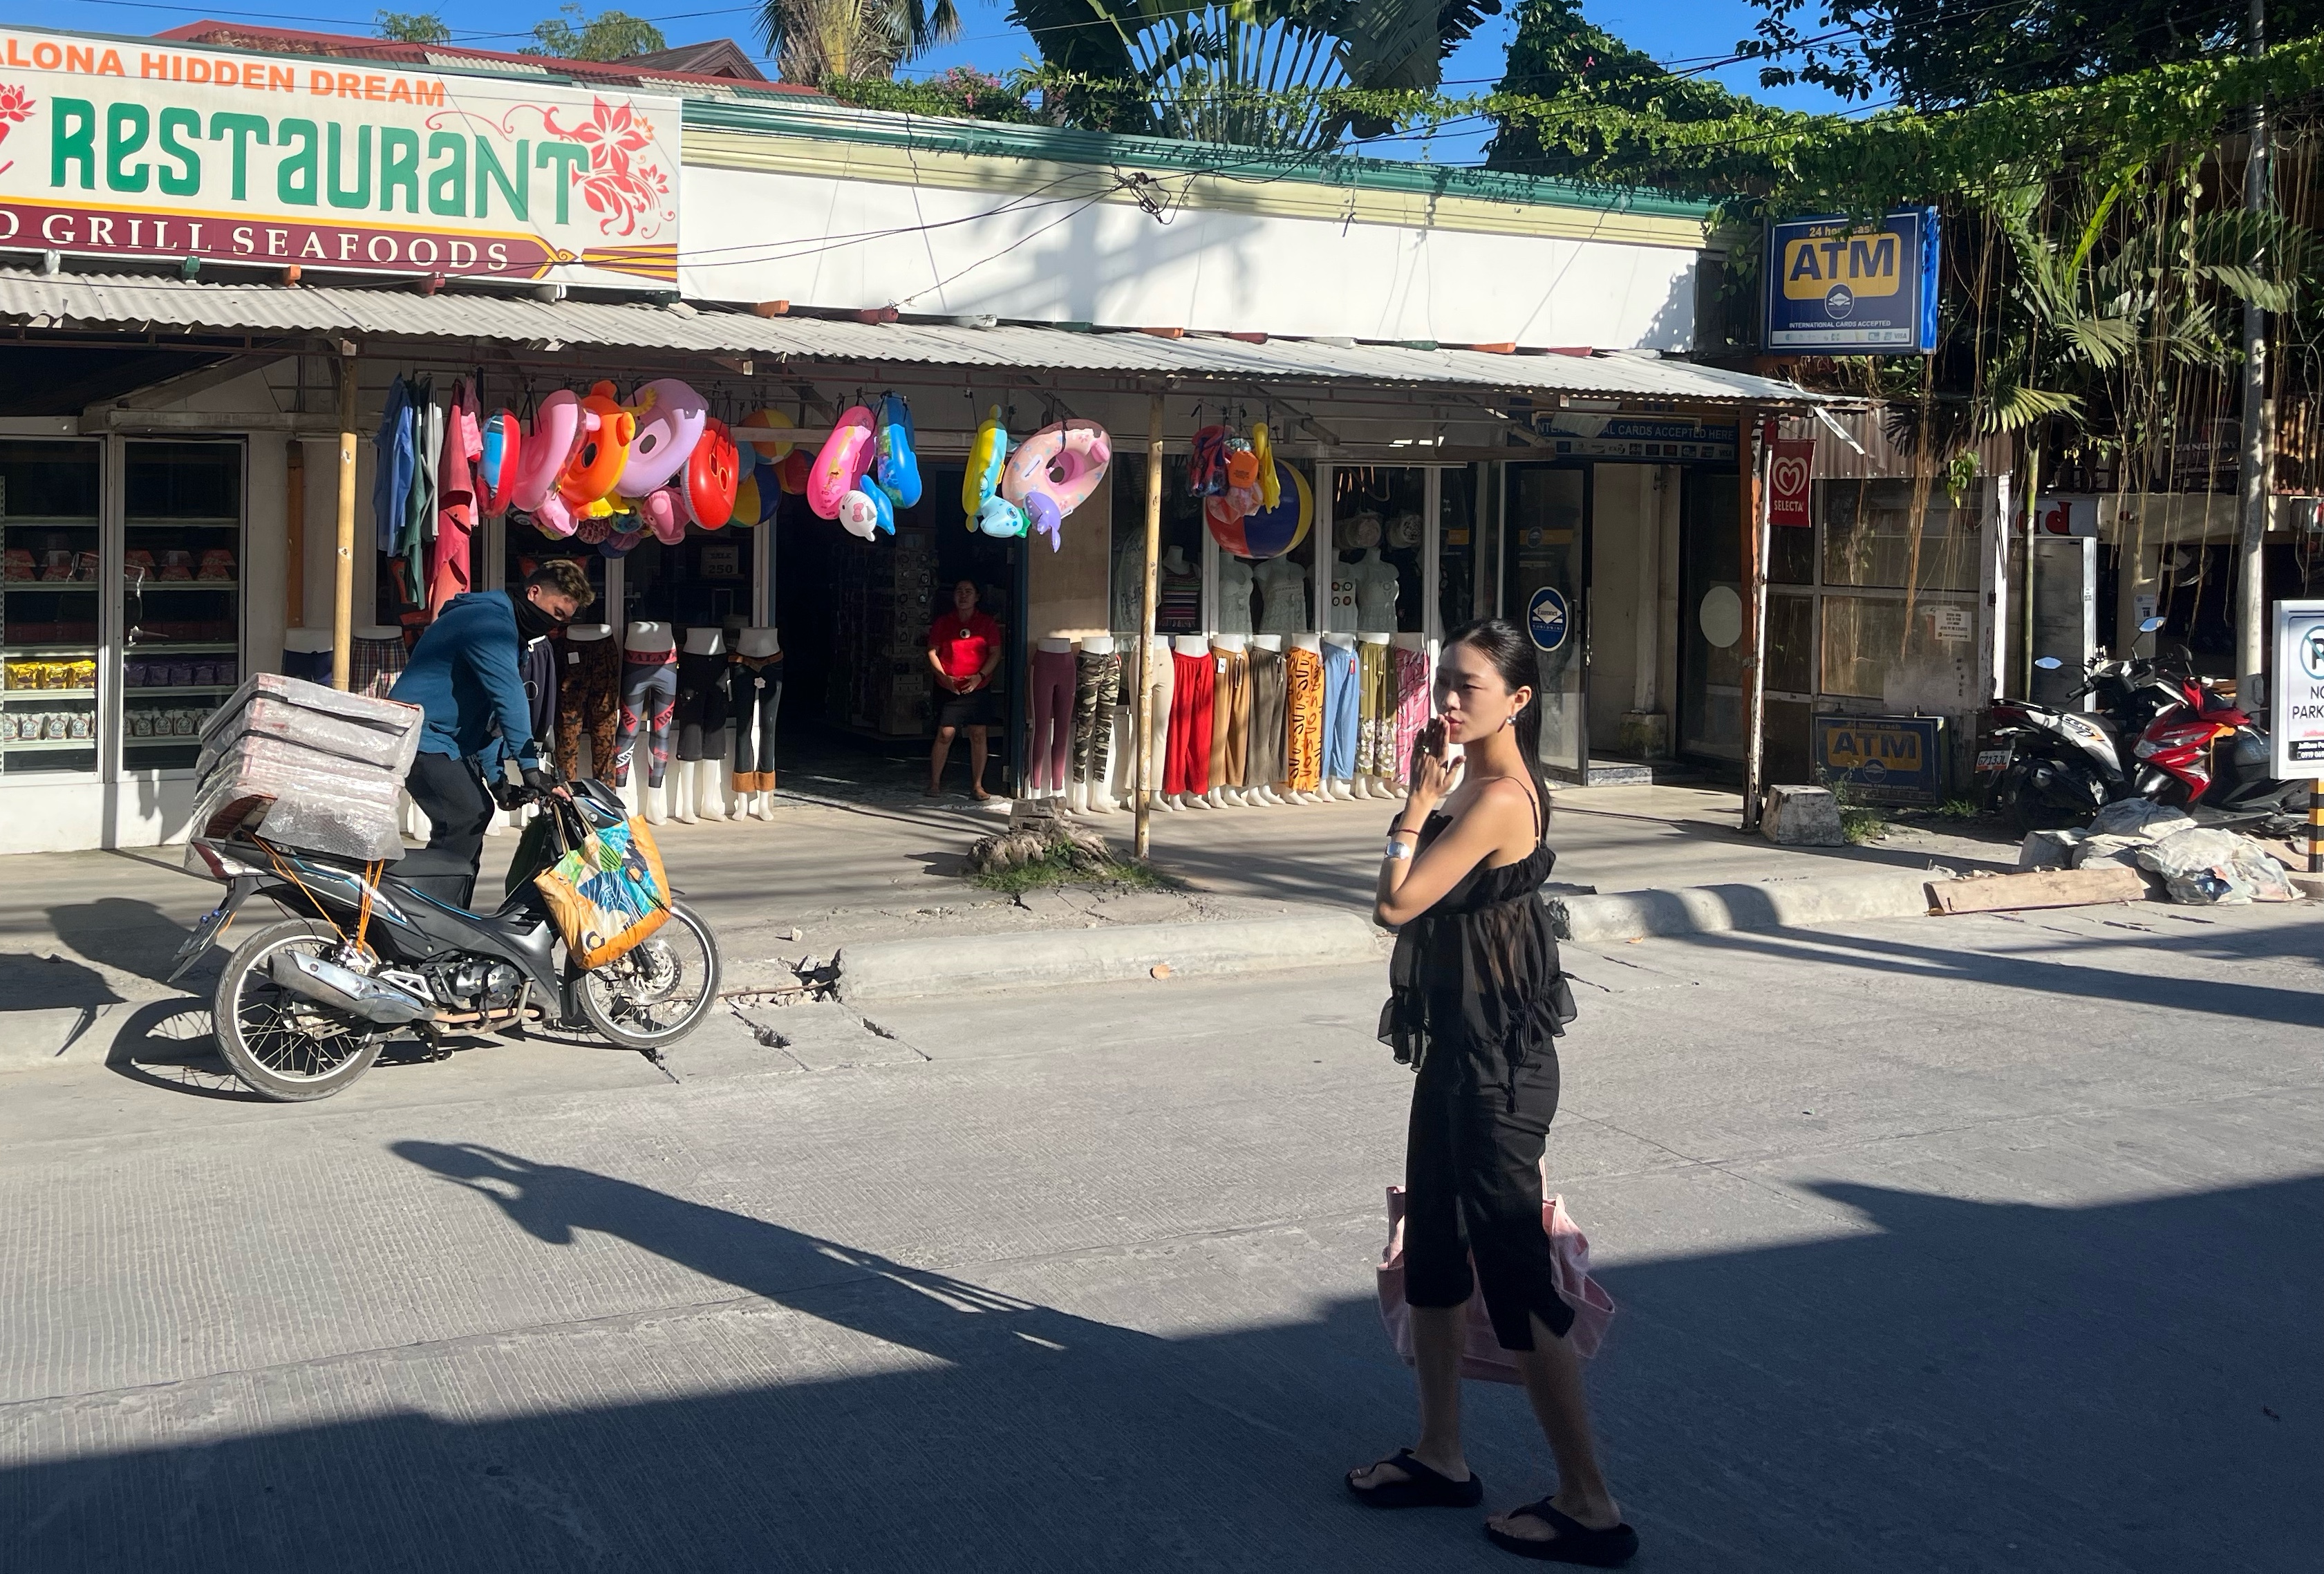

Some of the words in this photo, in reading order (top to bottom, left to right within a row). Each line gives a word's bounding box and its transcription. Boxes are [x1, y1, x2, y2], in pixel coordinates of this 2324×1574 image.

[140, 52, 294, 93] HIDDEN
[310, 69, 444, 107] DREAM
[42, 214, 212, 253] GRILL
[232, 227, 509, 271] SEAFOODS
[1809, 226, 1822, 237] 24
[1789, 238, 1895, 282] ATM
[1618, 424, 1653, 436] CARDS
[1655, 427, 1707, 439] ACCEPTED
[1708, 429, 1734, 440] HERE
[1774, 500, 1804, 512] SELECTA
[708, 564, 733, 574] 250
[1833, 731, 1916, 759] ATM
